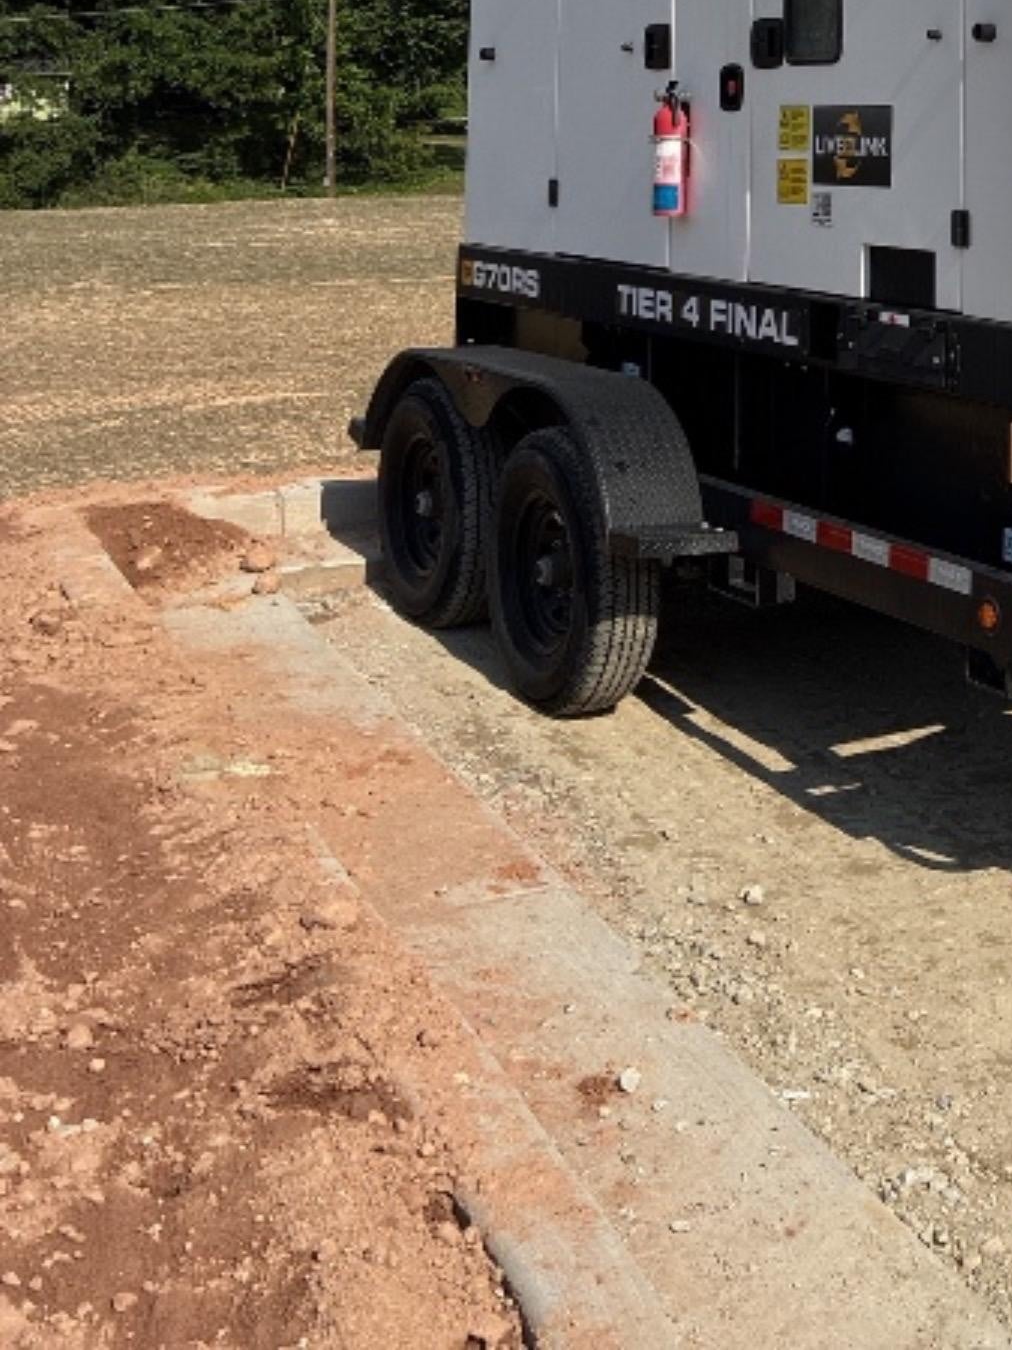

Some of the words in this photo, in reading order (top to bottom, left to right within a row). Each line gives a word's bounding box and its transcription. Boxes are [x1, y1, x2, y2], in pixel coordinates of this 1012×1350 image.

[472, 259, 539, 299] G70RS
[617, 283, 673, 323] TIER
[680, 296, 699, 327] 4
[710, 299, 798, 347] FINAL
